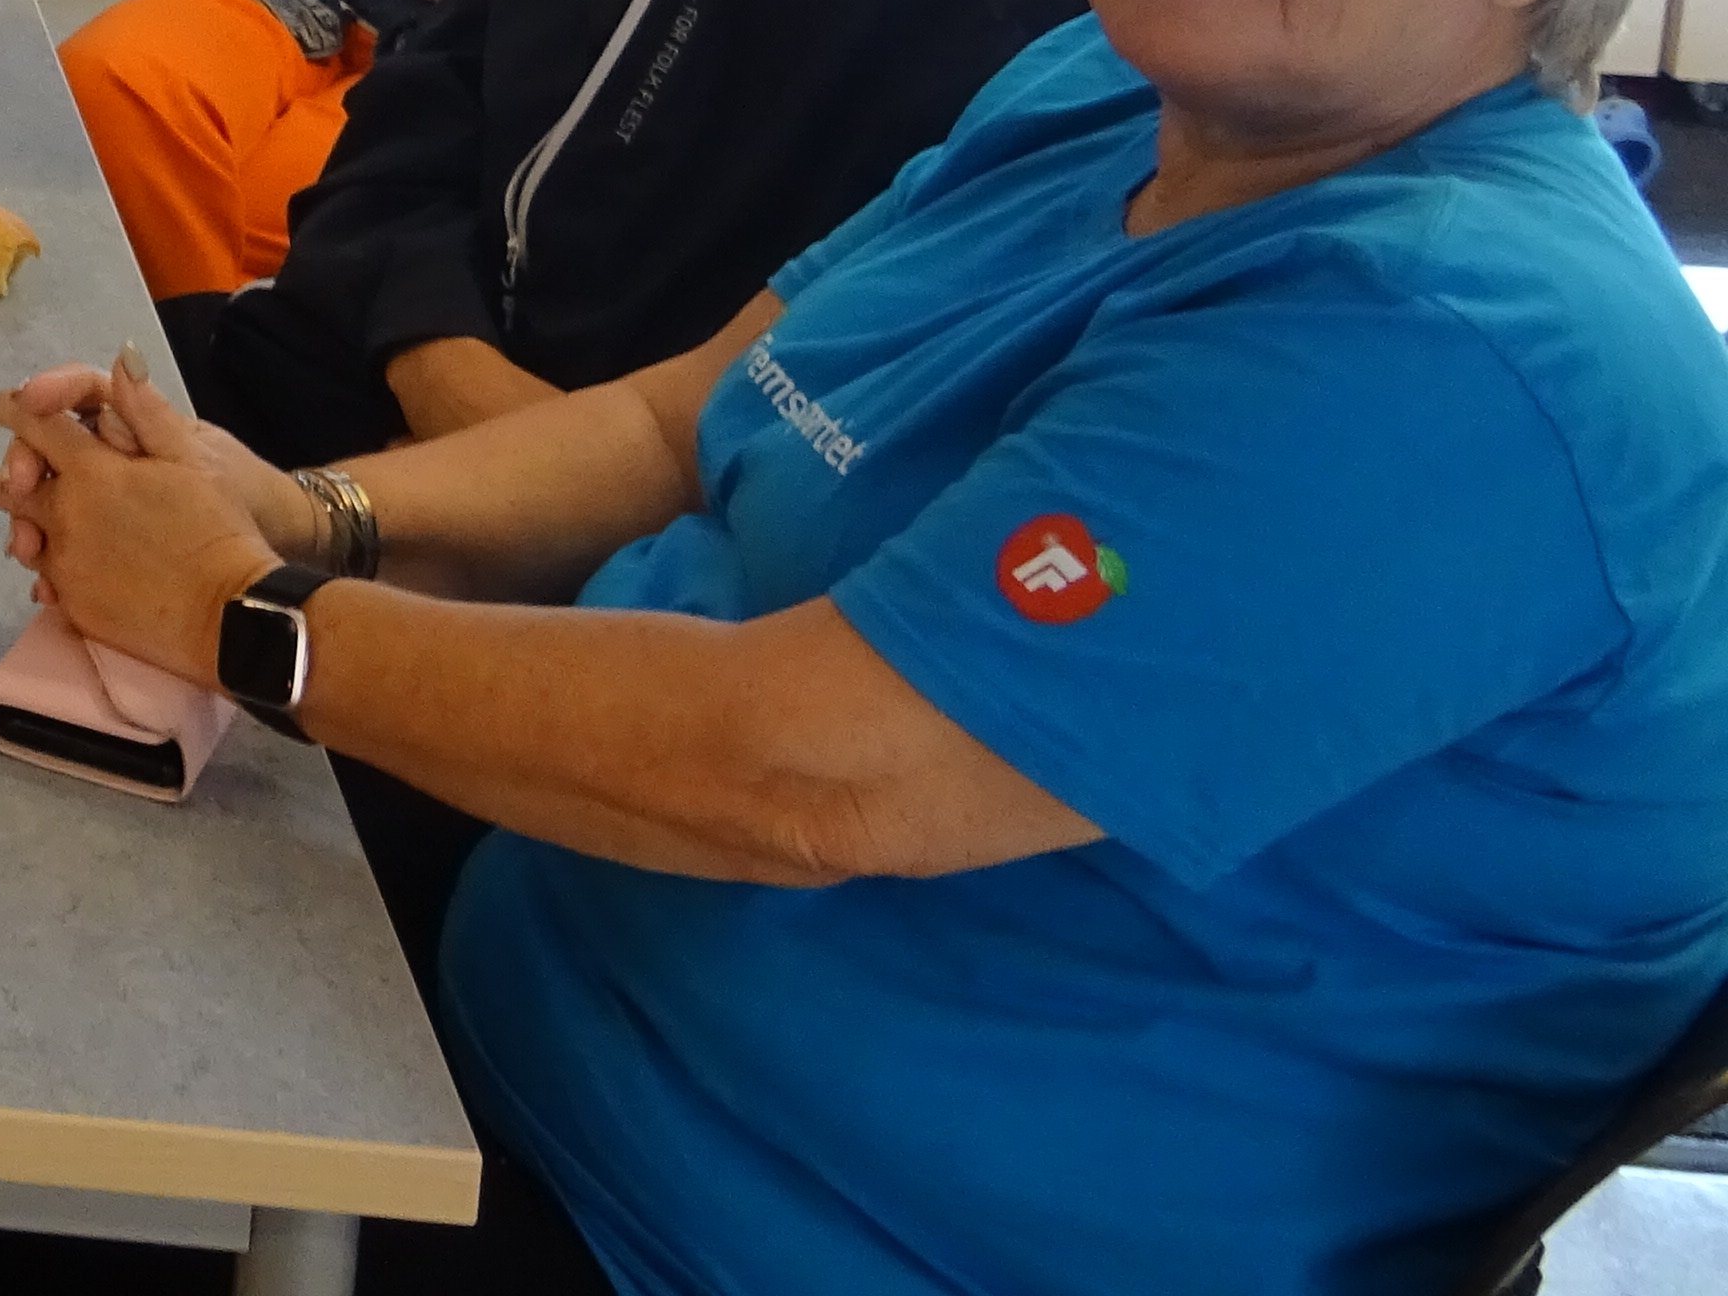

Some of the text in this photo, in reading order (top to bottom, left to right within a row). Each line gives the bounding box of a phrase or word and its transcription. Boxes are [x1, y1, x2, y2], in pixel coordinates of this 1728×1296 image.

[670, 4, 698, 44] FOR
[645, 40, 679, 89] FOLK
[616, 87, 654, 145] FLEST
